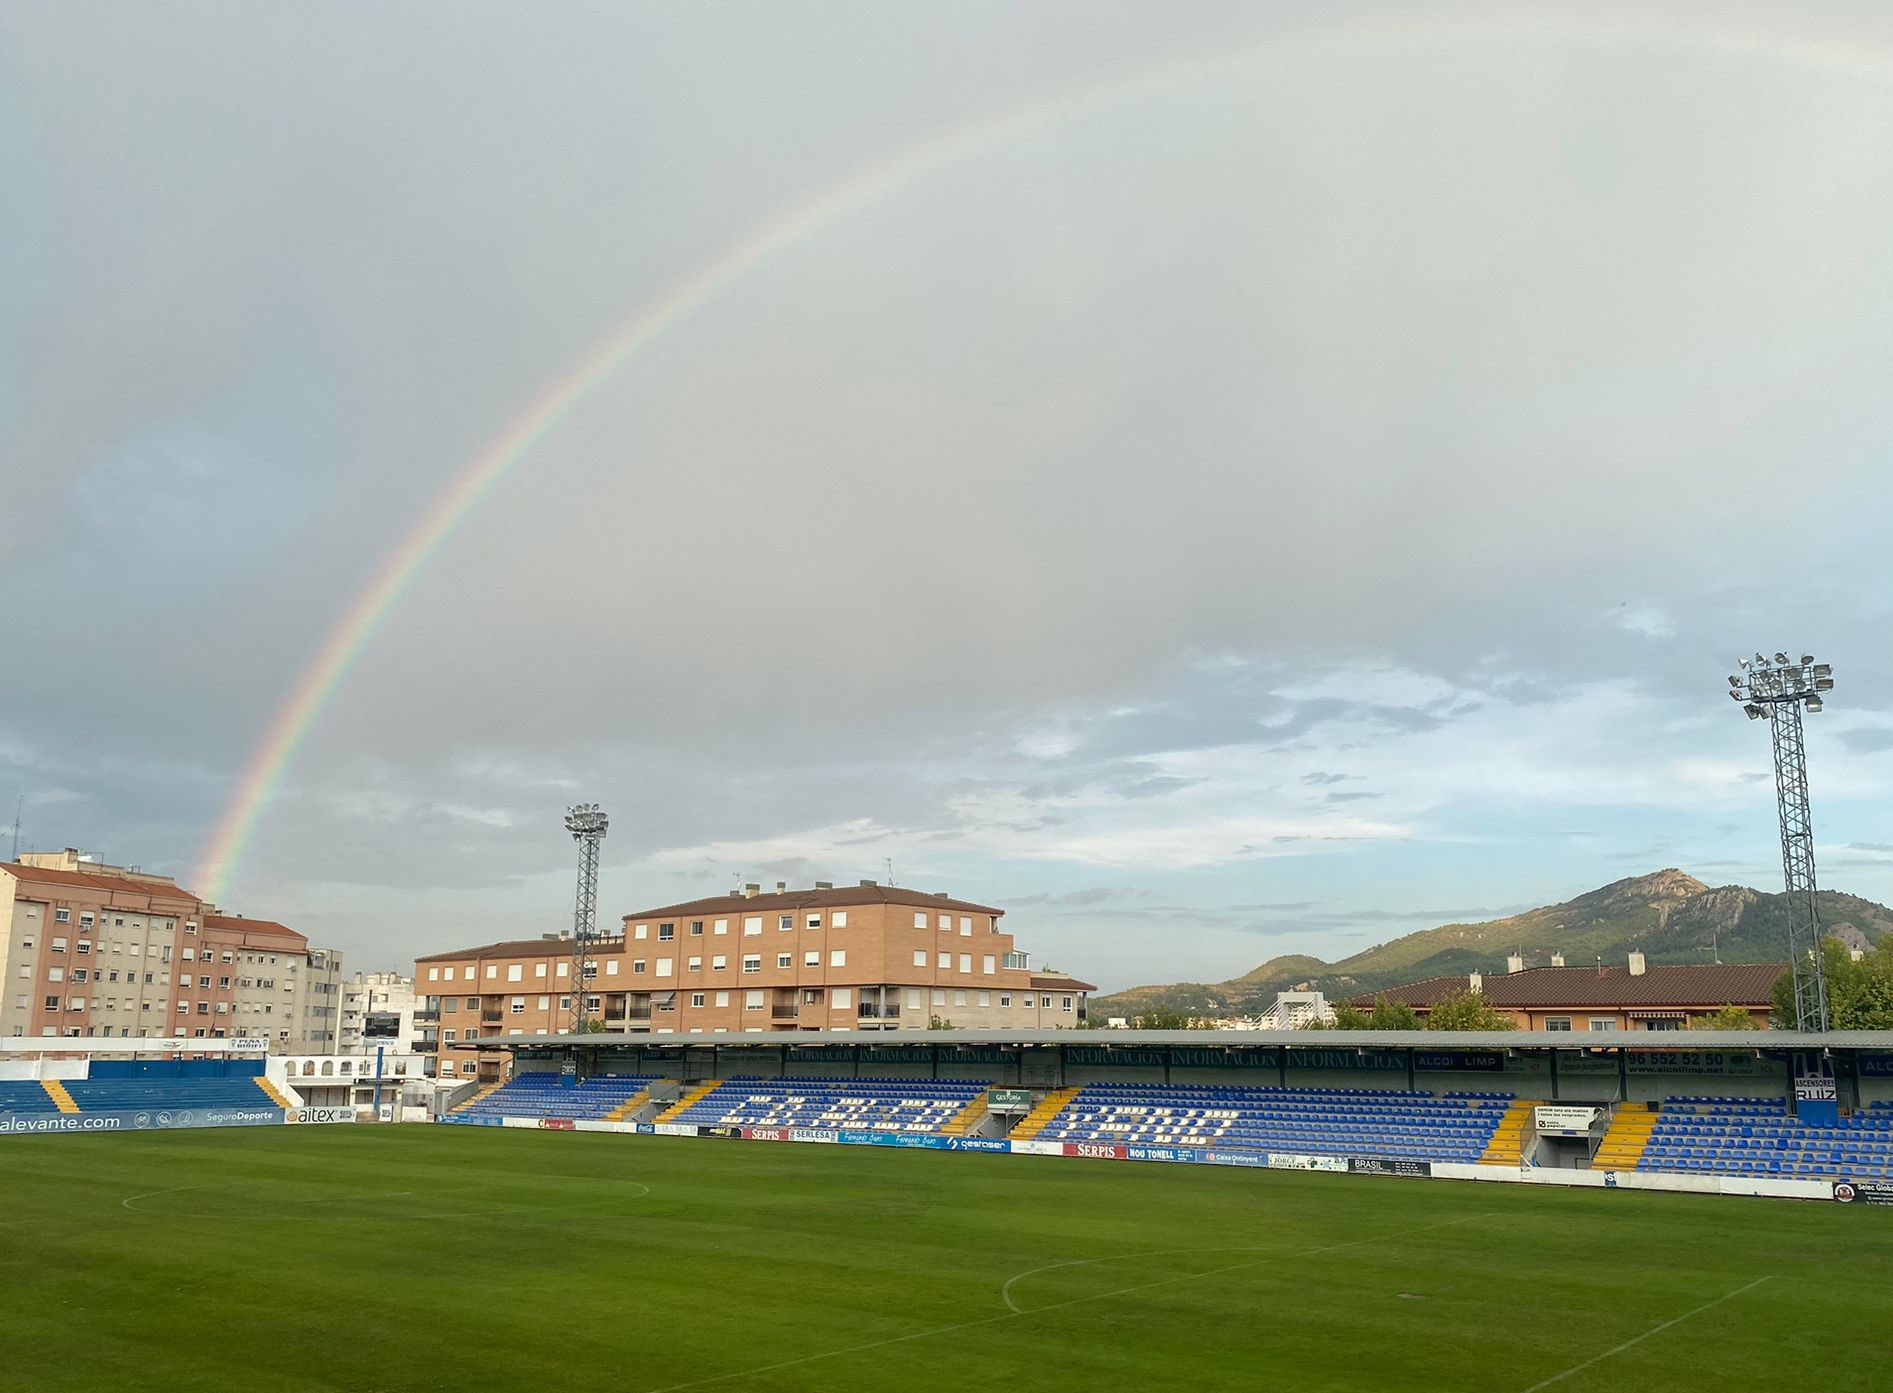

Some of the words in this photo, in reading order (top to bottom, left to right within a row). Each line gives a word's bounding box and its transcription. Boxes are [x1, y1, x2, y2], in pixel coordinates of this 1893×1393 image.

[1418, 1056, 1454, 1067] ALCOI
[1465, 1057, 1497, 1067] LIMP
[1628, 1052, 1646, 1065] 96
[1651, 1052, 1677, 1065] 552
[1682, 1052, 1699, 1065] 52
[1705, 1053, 1724, 1066] 50
[1795, 1079, 1836, 1088] ASCENSORES
[207, 1111, 274, 1122] SeguroDeporte
[298, 1107, 335, 1122] aitex
[0, 1117, 120, 1131] alevante.com
[752, 1128, 779, 1140] SERPIS
[797, 1130, 829, 1139] SERLESA
[1077, 1143, 1115, 1157] SERPIS
[1129, 1149, 1145, 1158] NOU
[1147, 1149, 1174, 1160] TONELL
[1355, 1159, 1383, 1170] BRASIL
